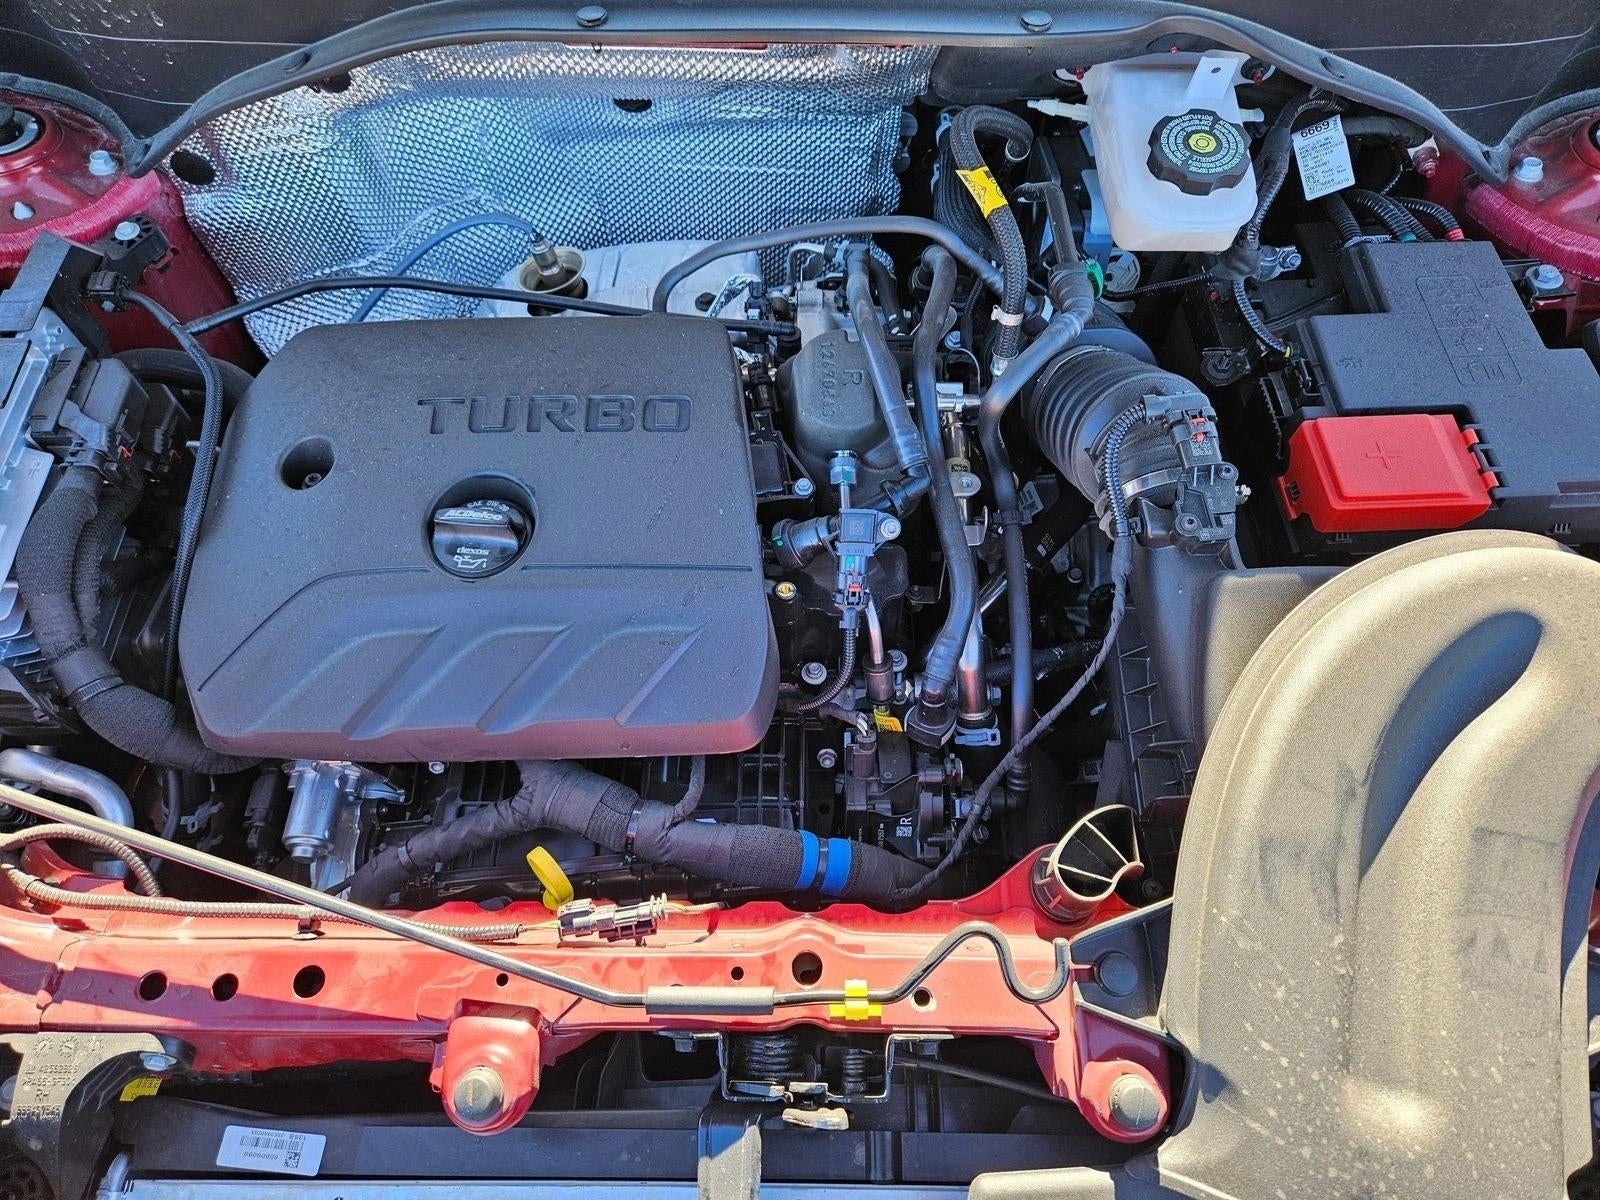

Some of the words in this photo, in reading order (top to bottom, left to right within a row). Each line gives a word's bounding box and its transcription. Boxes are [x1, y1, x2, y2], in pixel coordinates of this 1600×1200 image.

[1300, 119, 1330, 139] 6669
[843, 370, 864, 385] R
[417, 395, 692, 434] TURBO
[443, 509, 503, 520] ACDelco
[456, 546, 491, 556] dexos
[900, 817, 912, 825] R
